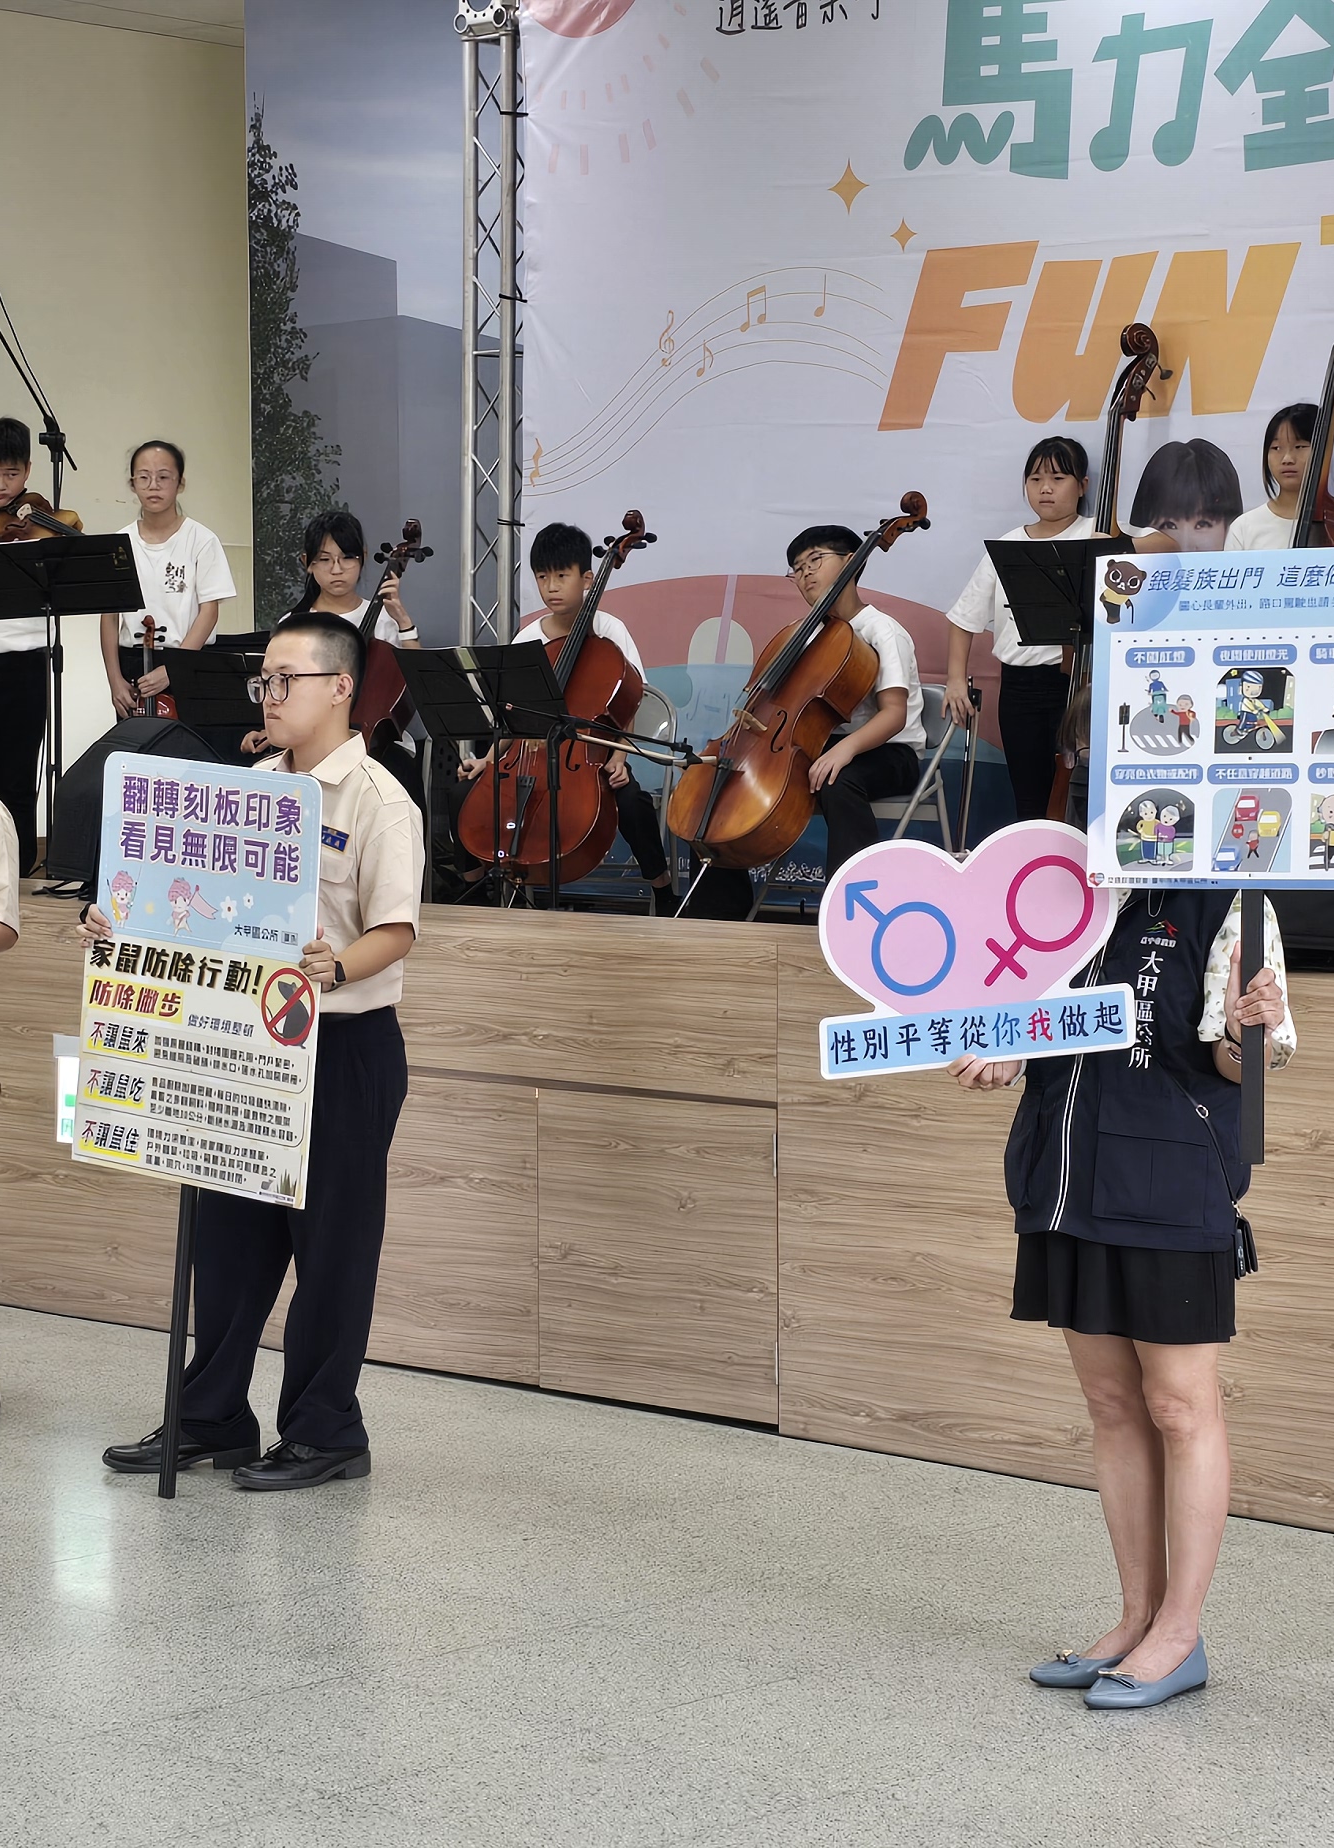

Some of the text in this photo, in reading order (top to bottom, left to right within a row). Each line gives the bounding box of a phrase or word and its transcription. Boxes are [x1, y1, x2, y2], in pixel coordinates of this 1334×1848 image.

[1148, 566, 1265, 592] 銀髮族出門
[122, 775, 302, 836] 翻轉刻板印象
[120, 820, 300, 884] 看見無限可能
[89, 939, 265, 996] 家鼠防除行動!
[830, 1000, 1126, 1065] 性別平等從你我做起
